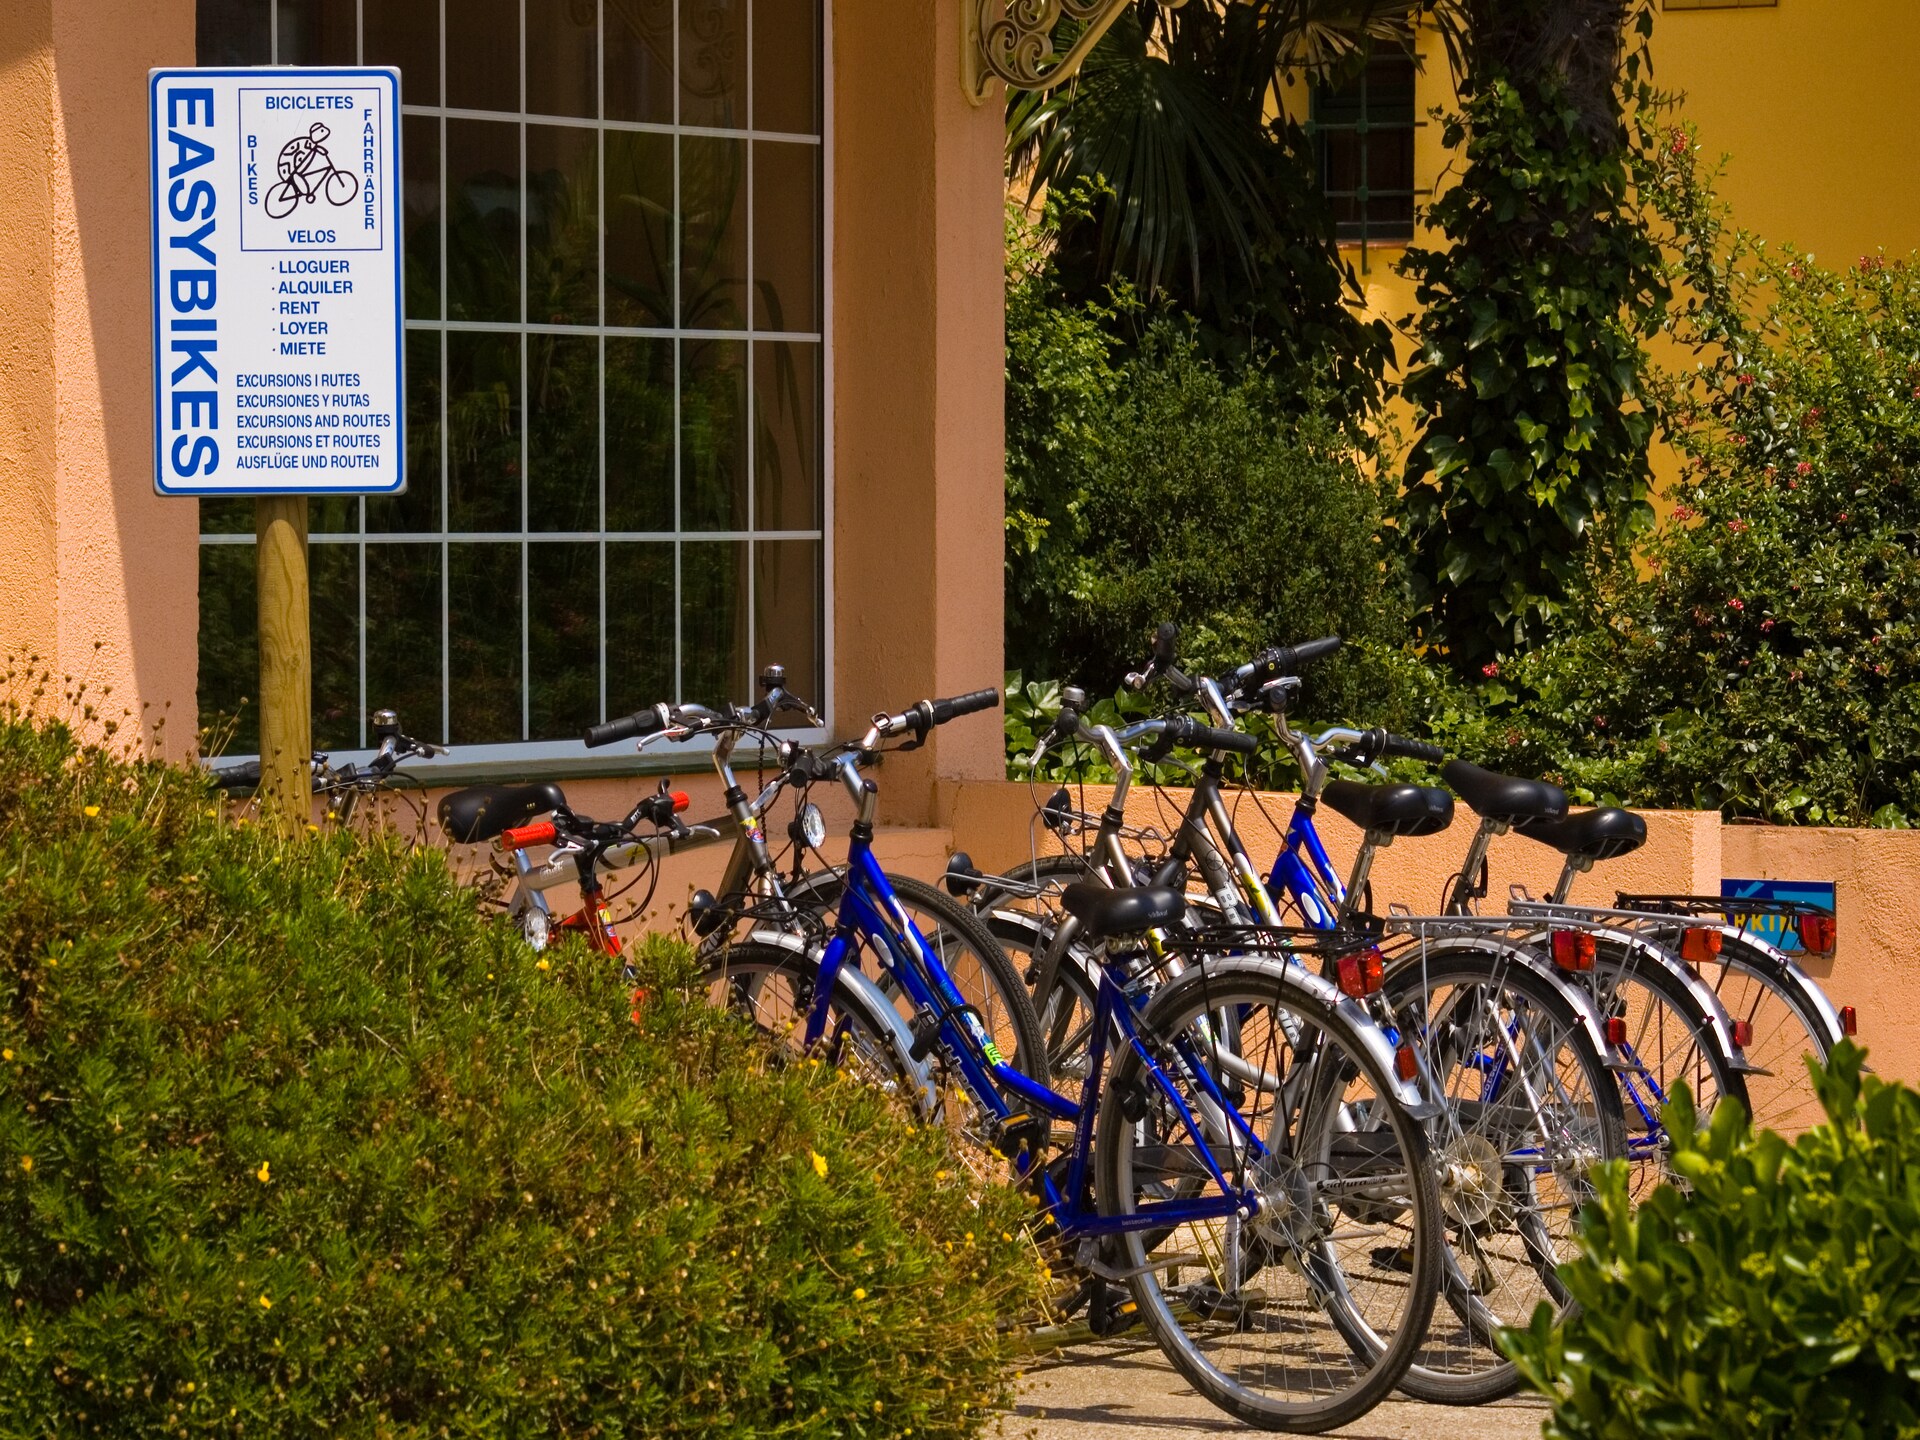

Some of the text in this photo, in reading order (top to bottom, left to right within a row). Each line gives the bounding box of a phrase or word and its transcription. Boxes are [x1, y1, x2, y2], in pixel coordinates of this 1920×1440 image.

[266, 96, 353, 109] BICICLETES
[247, 135, 258, 204] BIKES
[363, 109, 375, 229] FAHRRÄDER
[288, 230, 336, 243] VELOS
[279, 260, 350, 273] LLOGUER
[168, 88, 219, 477] EASYBIKES
[278, 281, 353, 294] ALQUILER
[279, 301, 320, 314] RENT
[280, 322, 328, 335] LOYER
[280, 342, 326, 355] MIETE
[236, 374, 312, 387] EXCURSIONS
[321, 374, 360, 387] RUTES
[236, 394, 370, 408] EXCURSIONES Y RUTAS
[236, 414, 390, 428] EXCURSIONS AND ROUTES
[237, 435, 381, 449] EXCURSIONS ET ROUTES
[236, 453, 379, 469] AUSFLÜGE UND ROUTEN
